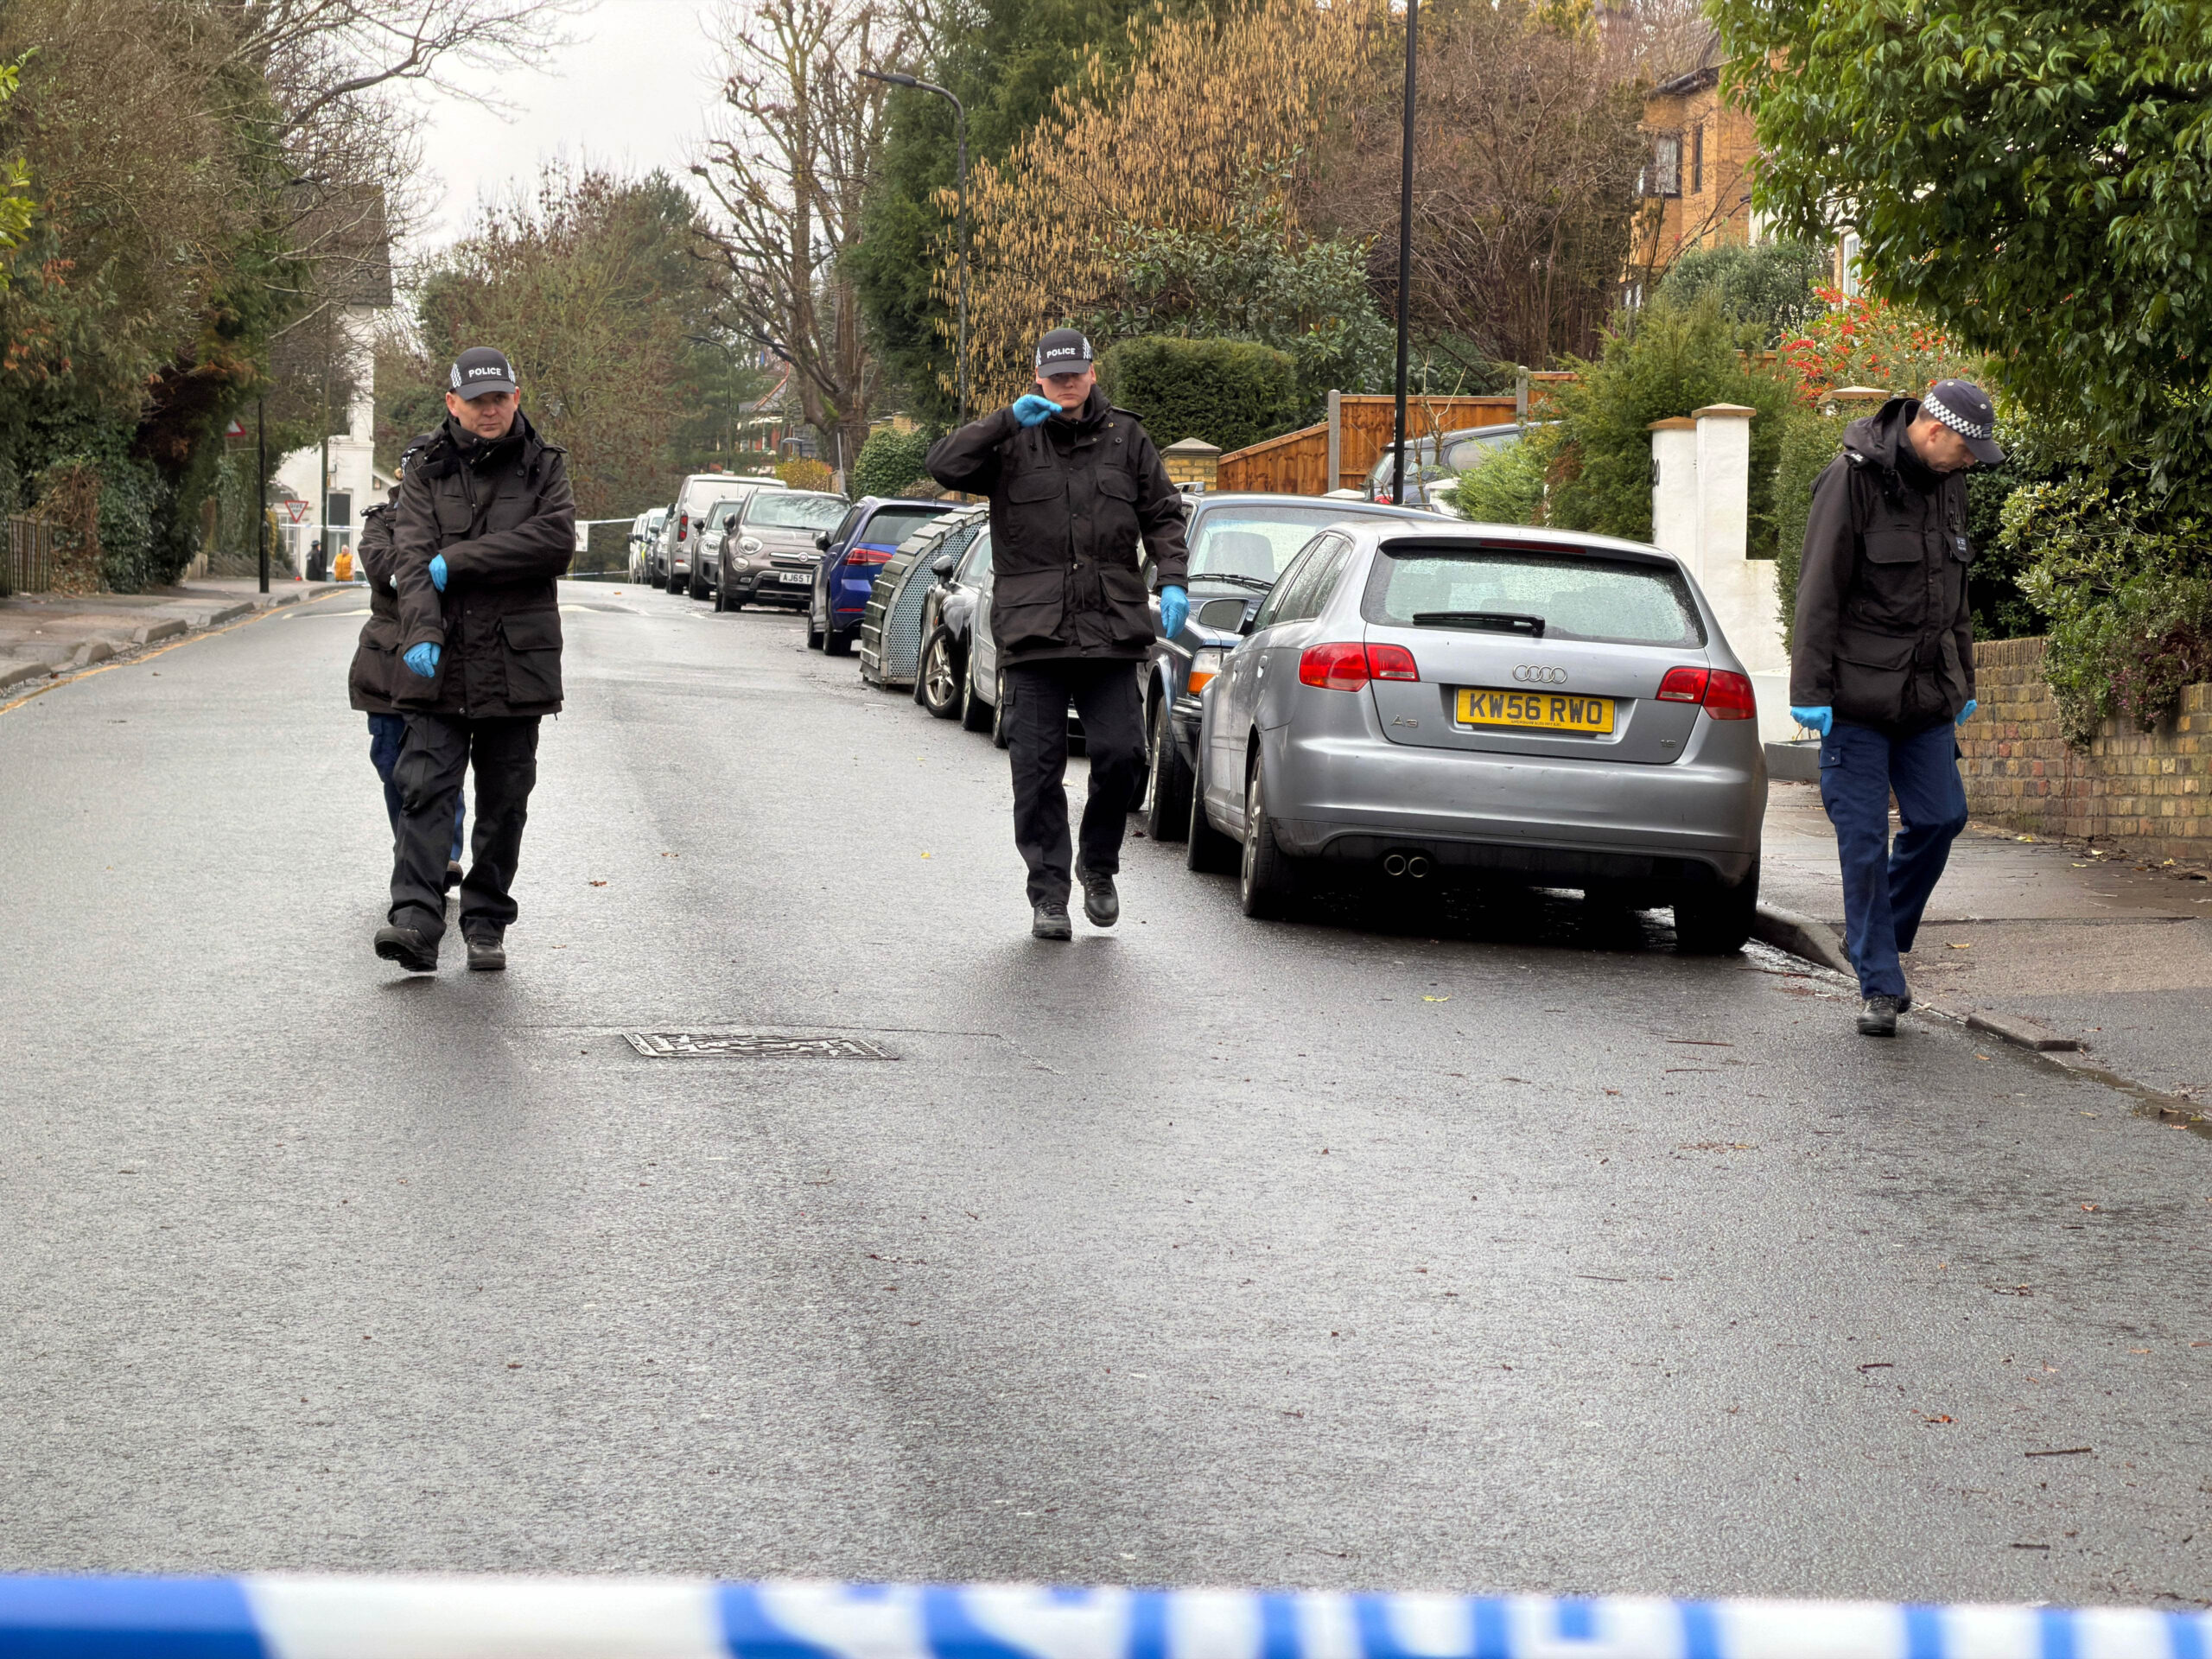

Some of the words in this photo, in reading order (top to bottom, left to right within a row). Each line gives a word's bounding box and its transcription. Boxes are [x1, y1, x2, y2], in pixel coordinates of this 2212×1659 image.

[1046, 347, 1076, 359] POLICE
[468, 367, 502, 378] POLICE
[782, 573, 804, 582] AJ65
[1469, 693, 1541, 720] KW56
[1549, 697, 1602, 725] RWO
[1390, 715, 1418, 728] A3
